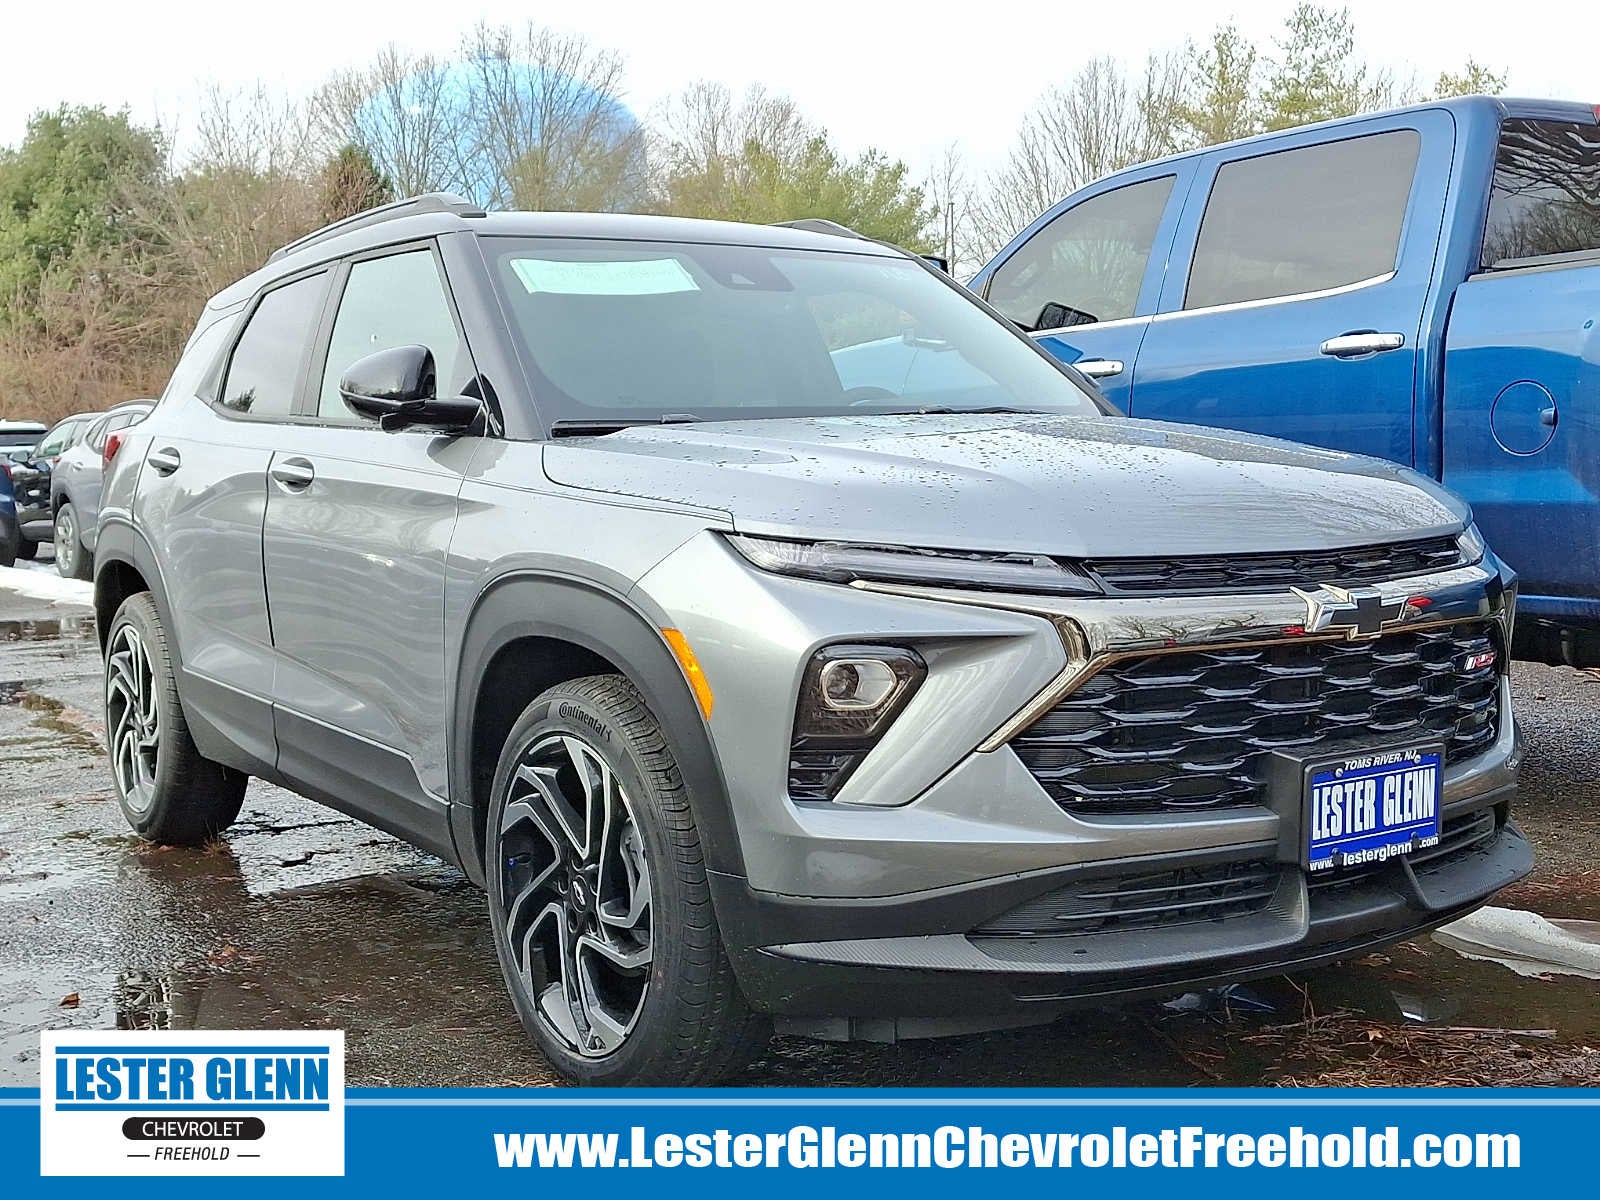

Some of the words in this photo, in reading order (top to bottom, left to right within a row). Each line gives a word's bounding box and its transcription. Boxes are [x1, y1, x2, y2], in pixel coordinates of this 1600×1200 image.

[559, 702, 606, 736] Continental
[1344, 758, 1371, 770] TOMS
[1373, 753, 1403, 765] RIVER,
[1404, 749, 1416, 760] NJ
[1312, 779, 1376, 840] LESTER
[1383, 767, 1435, 826] GLENN
